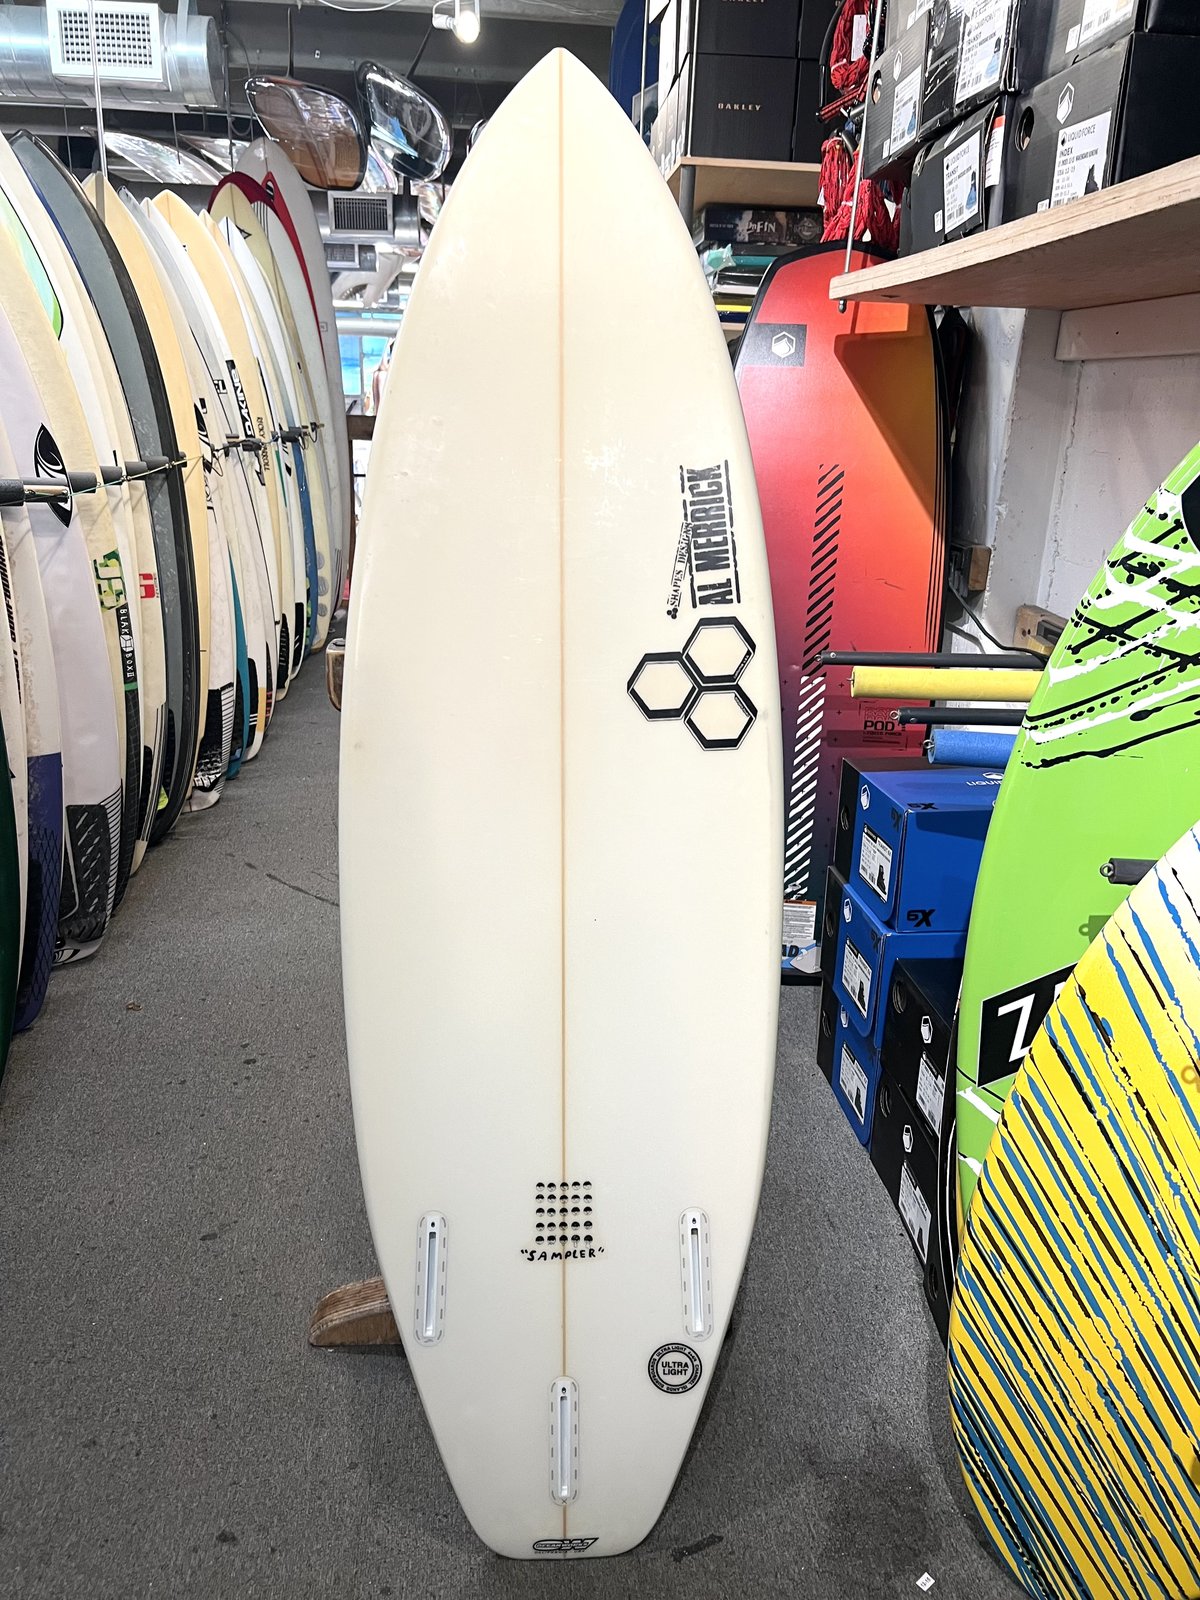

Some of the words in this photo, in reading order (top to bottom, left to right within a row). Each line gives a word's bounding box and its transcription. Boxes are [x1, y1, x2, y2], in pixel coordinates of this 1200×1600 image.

[718, 103, 761, 111] OAKLEY
[686, 464, 731, 573] MERRICK
[670, 569, 683, 606] SHAPES
[698, 577, 734, 605] AL
[863, 720, 896, 732] POD
[906, 908, 936, 928] 6X
[661, 1361, 689, 1369] ULTRA
[662, 1368, 689, 1376] LIGHT
